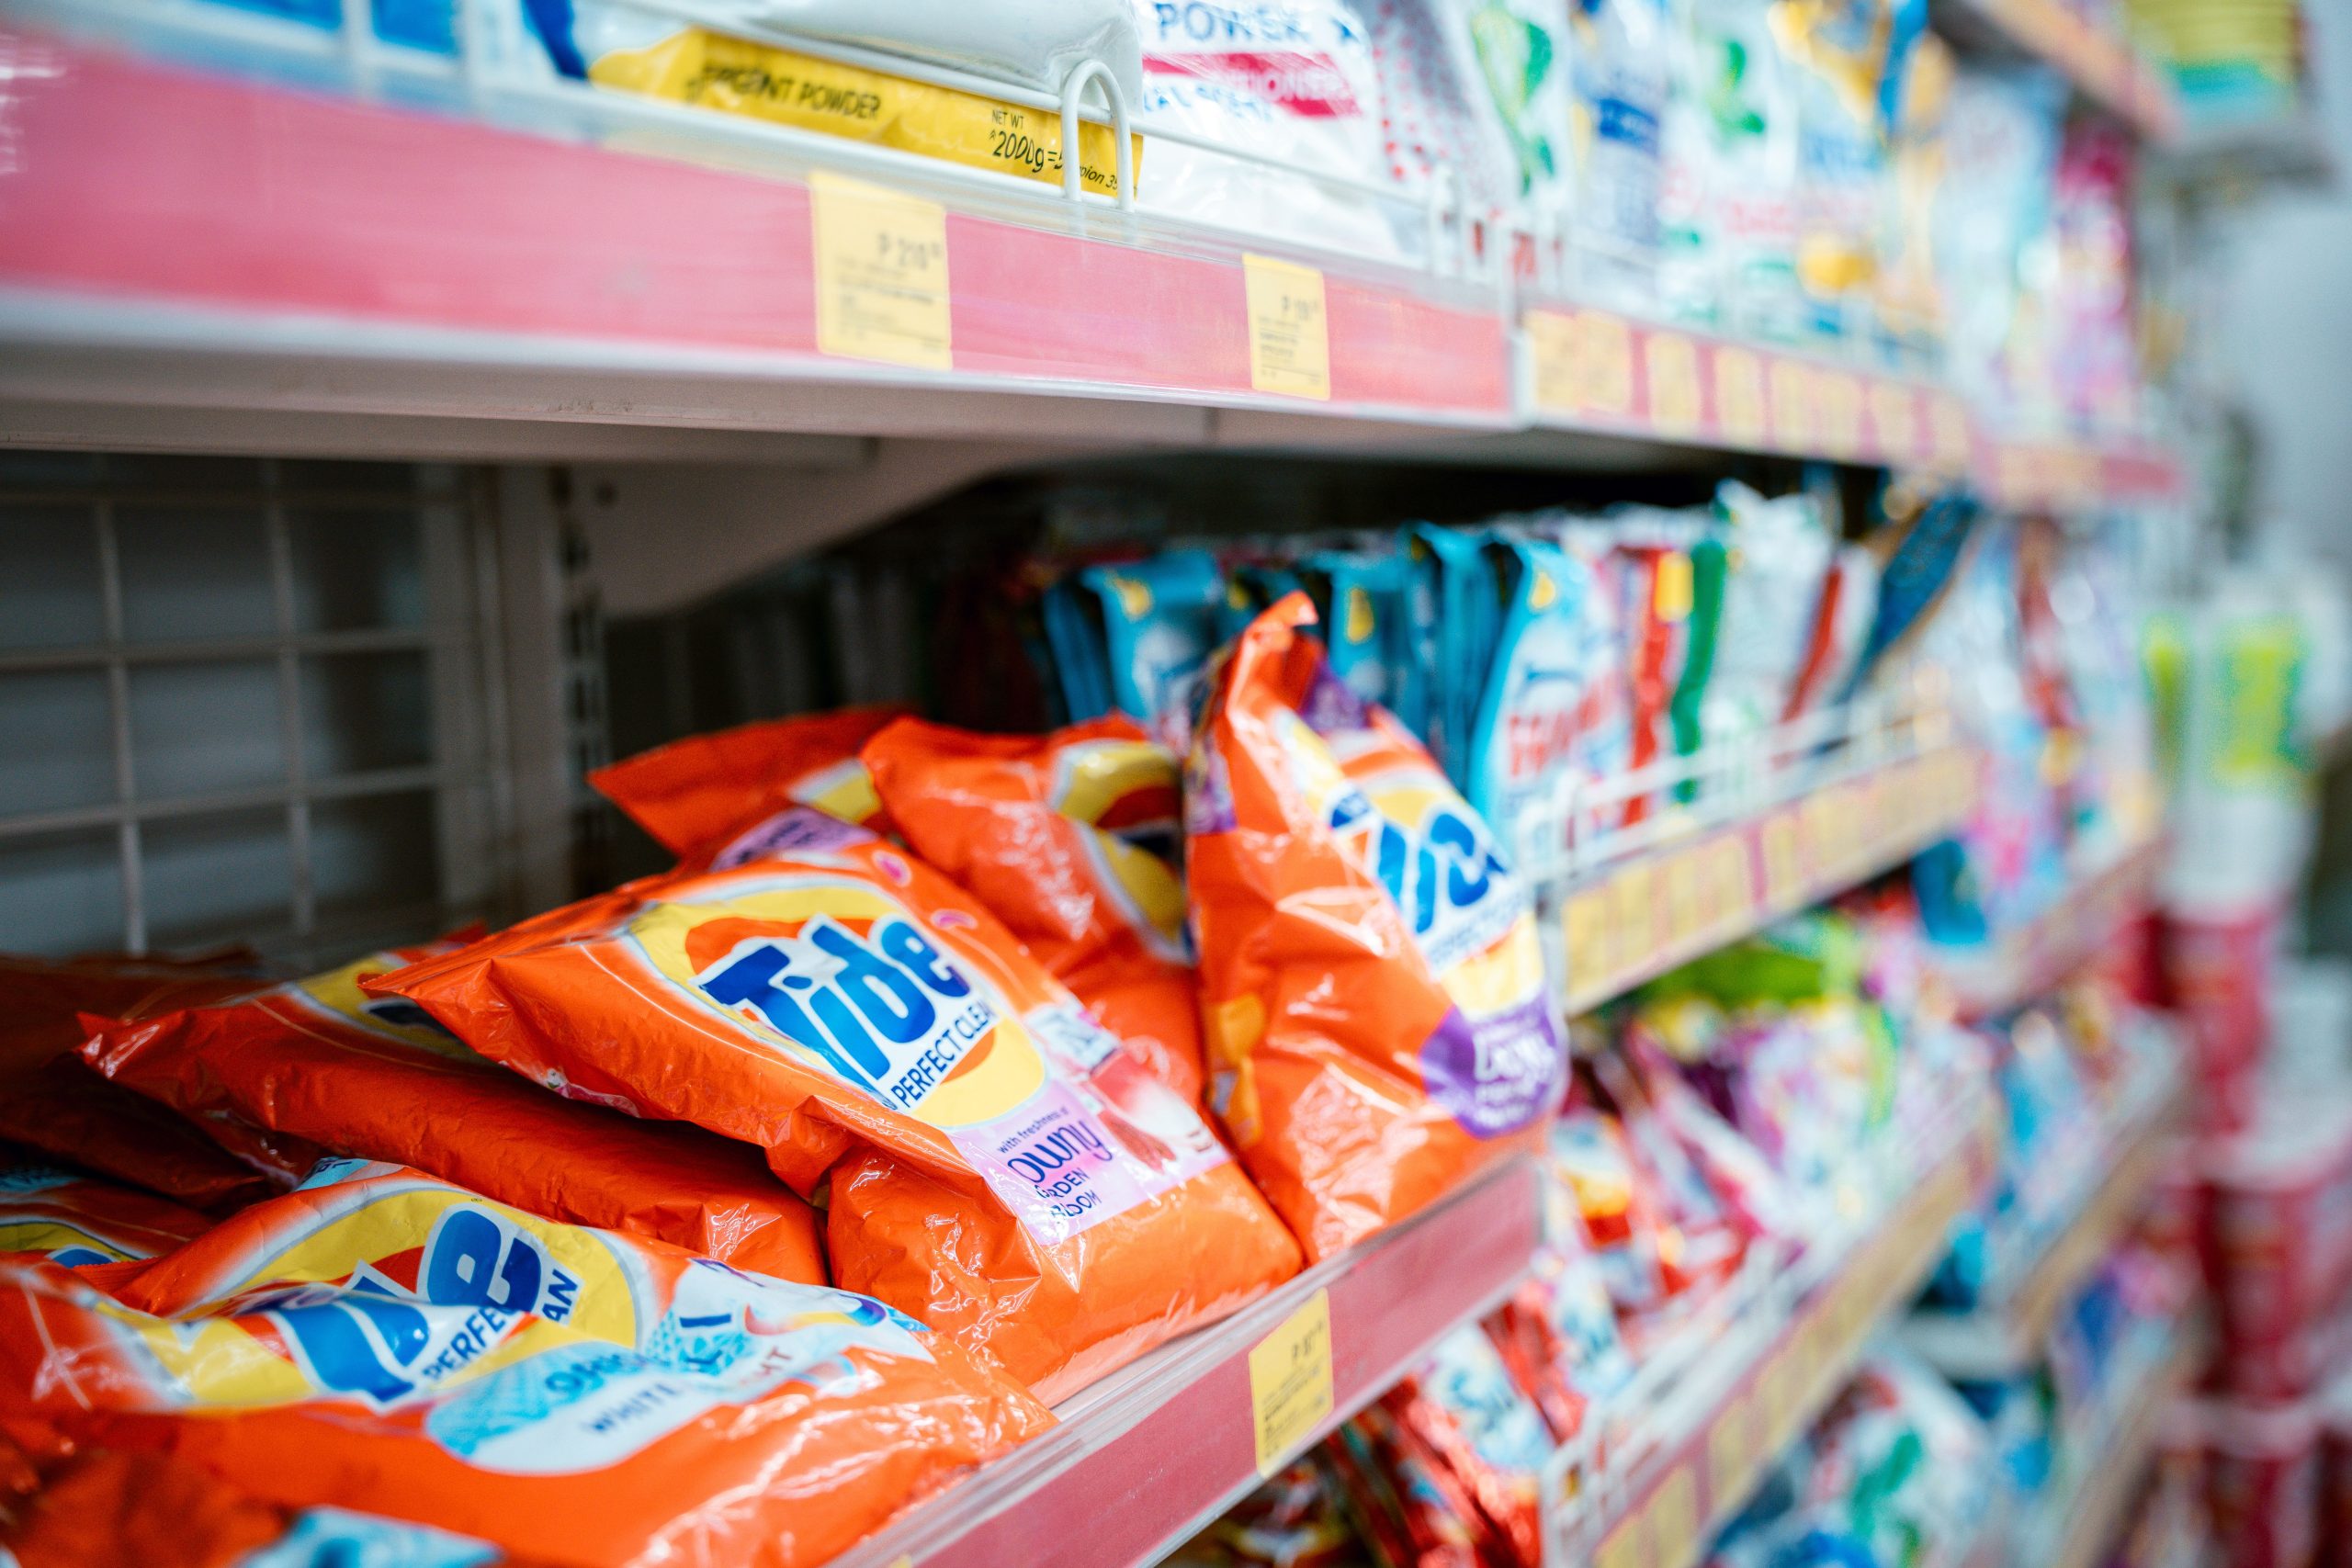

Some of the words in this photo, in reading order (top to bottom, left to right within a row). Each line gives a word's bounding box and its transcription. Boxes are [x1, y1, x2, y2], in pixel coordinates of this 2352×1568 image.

[797, 81, 882, 119] POWDER
[992, 110, 1007, 125] NET
[1011, 116, 1023, 129] WT
[699, 919, 970, 1110] Tide
[890, 1029, 963, 1108] PERFECT
[955, 998, 998, 1040] CLEA
[998, 1136, 1021, 1154] with
[423, 1305, 516, 1382] PERFEC
